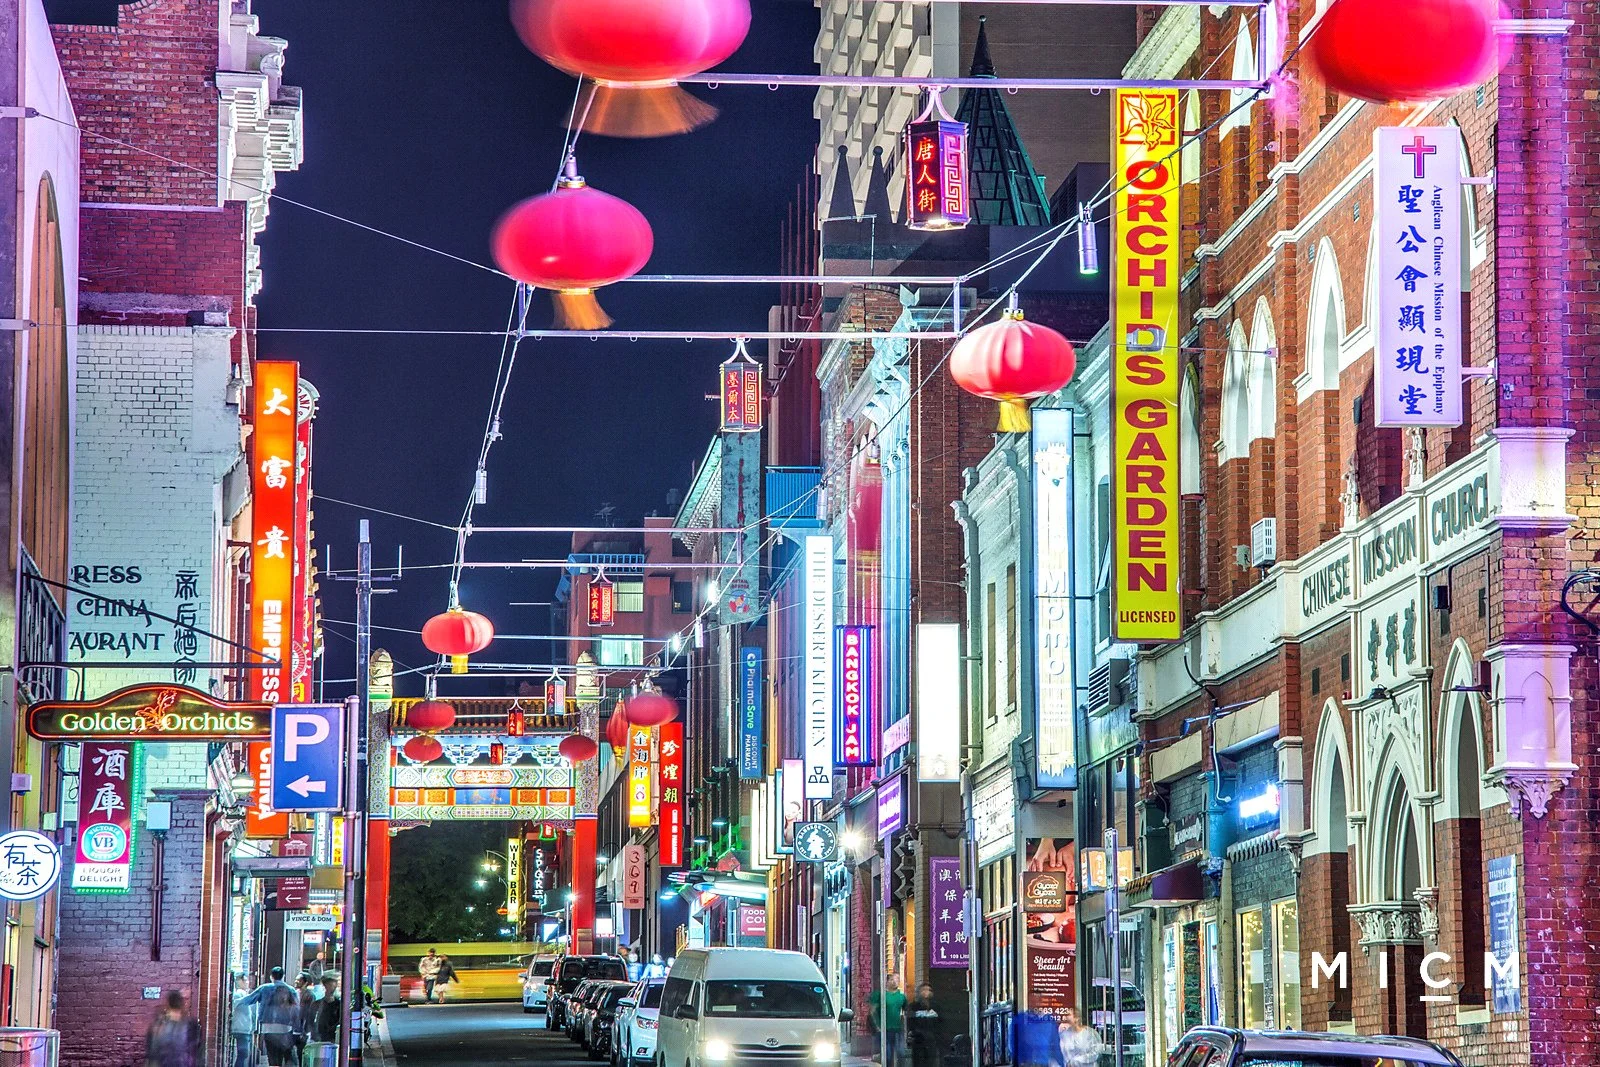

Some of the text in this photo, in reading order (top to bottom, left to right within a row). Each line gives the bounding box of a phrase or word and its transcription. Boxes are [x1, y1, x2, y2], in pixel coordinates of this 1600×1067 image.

[916, 137, 936, 212] 唐人街
[1394, 184, 1429, 416] 聖公會顯現堂
[1431, 185, 1445, 416] Anglican Chinese Mission of the Epiphany
[727, 370, 740, 424] 墨爾本
[1124, 160, 1168, 592] ORCHIDS GARDEN
[256, 387, 293, 559] 大富貴
[1362, 515, 1417, 586] MISSION
[76, 598, 152, 628] CHINA
[1119, 610, 1176, 623] LICENSED
[1302, 555, 1351, 618] CHINESE
[262, 599, 283, 704] EMPRESS
[60, 711, 254, 732] Golden Orchids
[746, 668, 756, 729] PharmaSave
[845, 634, 860, 757] BANGKOK JAM
[284, 713, 331, 762] P
[89, 747, 129, 821] 酒庫
[661, 739, 681, 804] 珍煌朝
[94, 836, 114, 848] VB
[509, 844, 519, 876] WINE
[534, 848, 544, 889] SPQR
[1033, 955, 1071, 964] Sheer Art
[1037, 962, 1065, 972] Beauty
